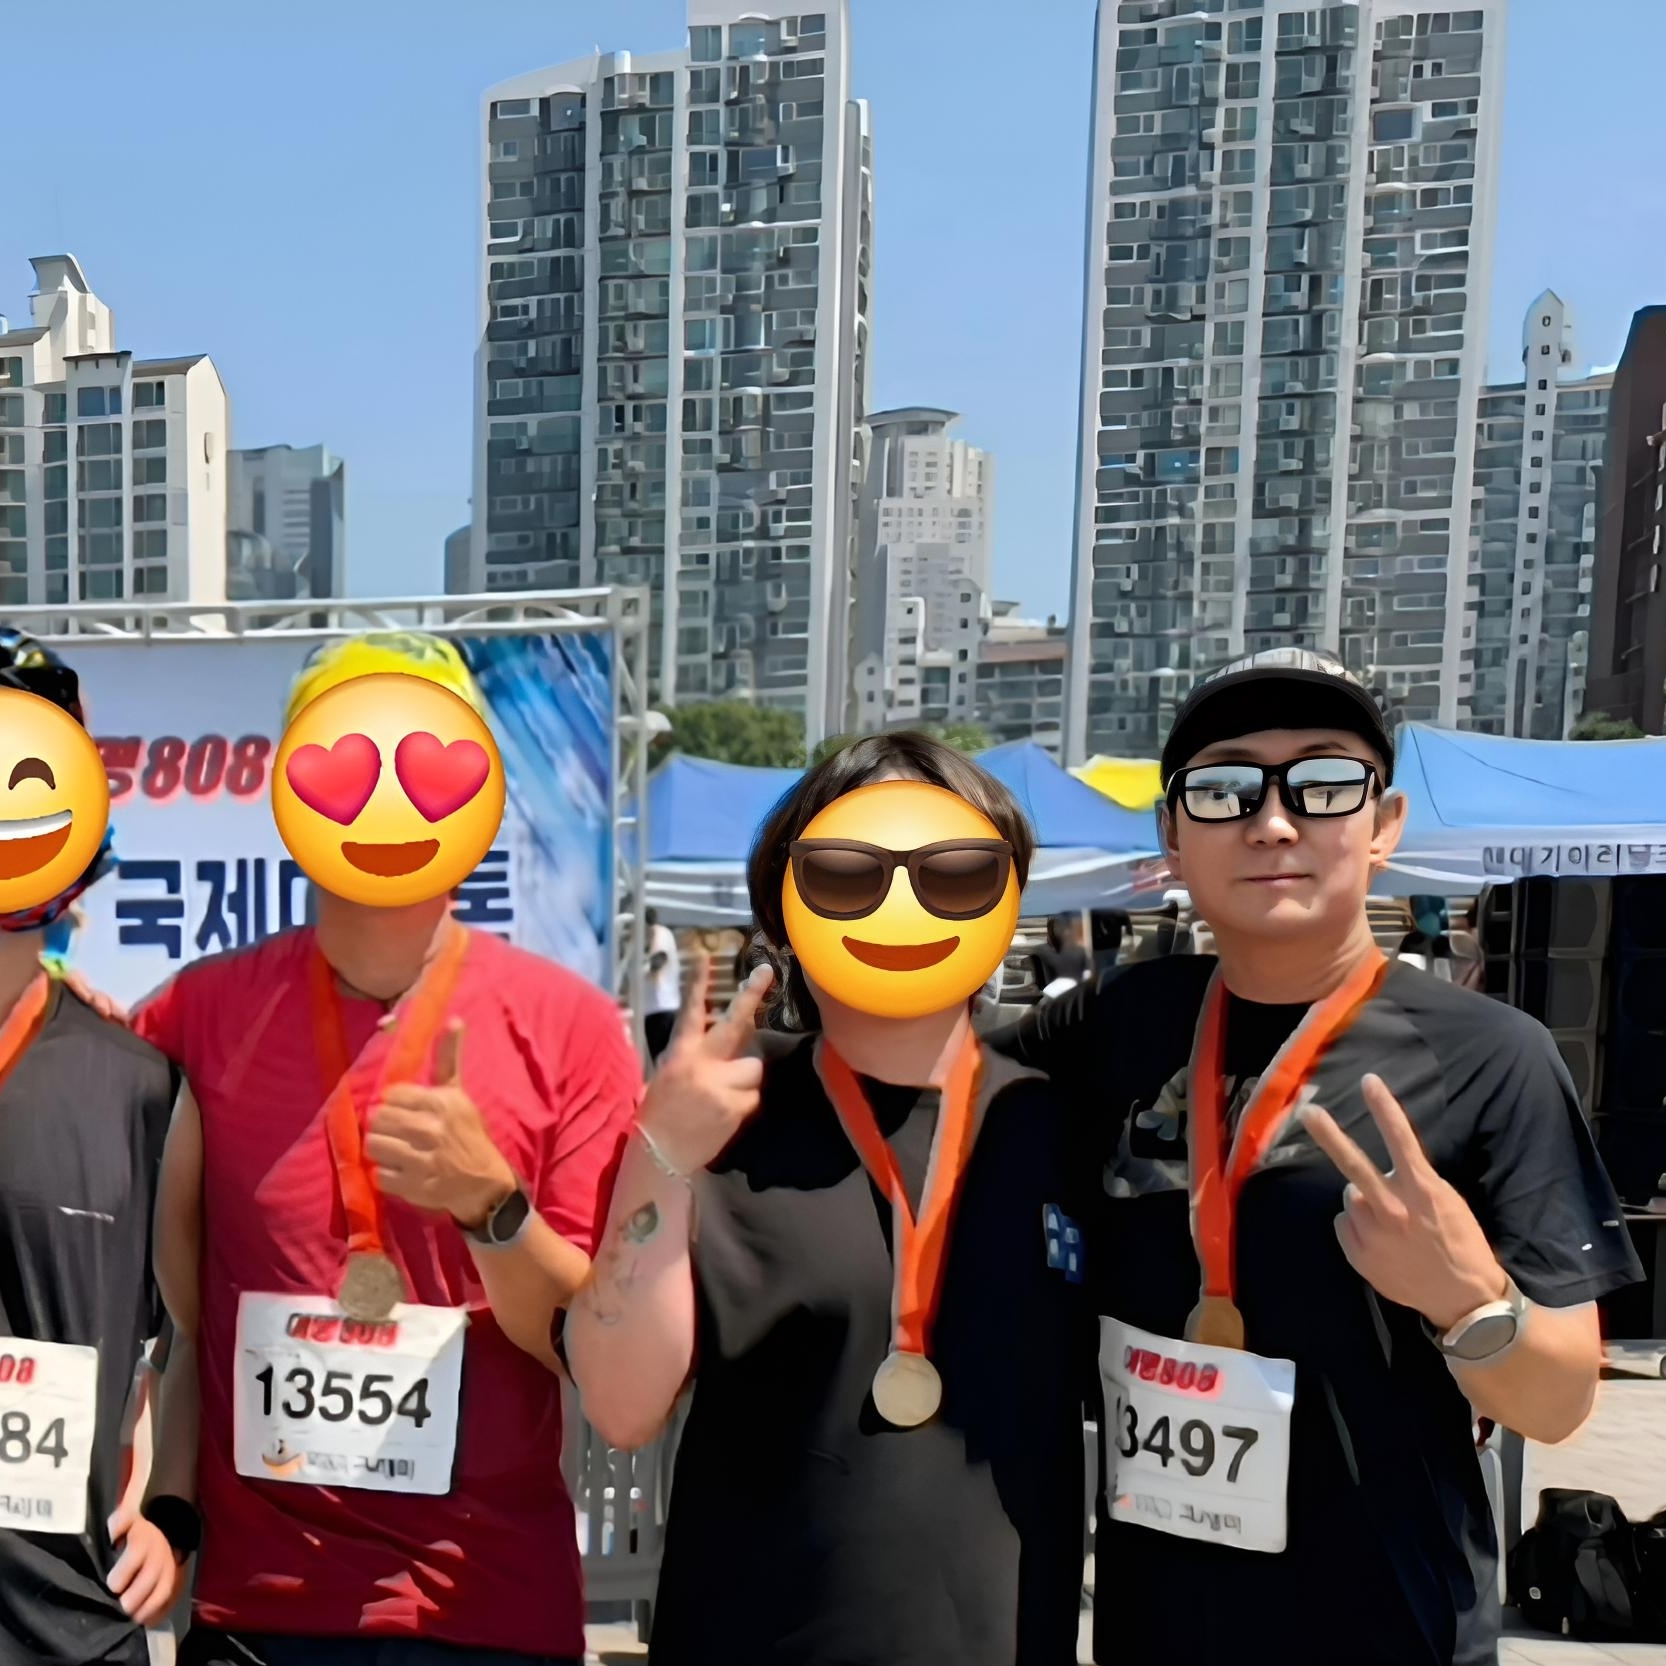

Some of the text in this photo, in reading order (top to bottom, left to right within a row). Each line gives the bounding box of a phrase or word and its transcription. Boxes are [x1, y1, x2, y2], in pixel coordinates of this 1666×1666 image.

[95, 733, 272, 799] 명808
[255, 1364, 432, 1428] 13554
[1116, 1395, 1259, 1484] 3497
